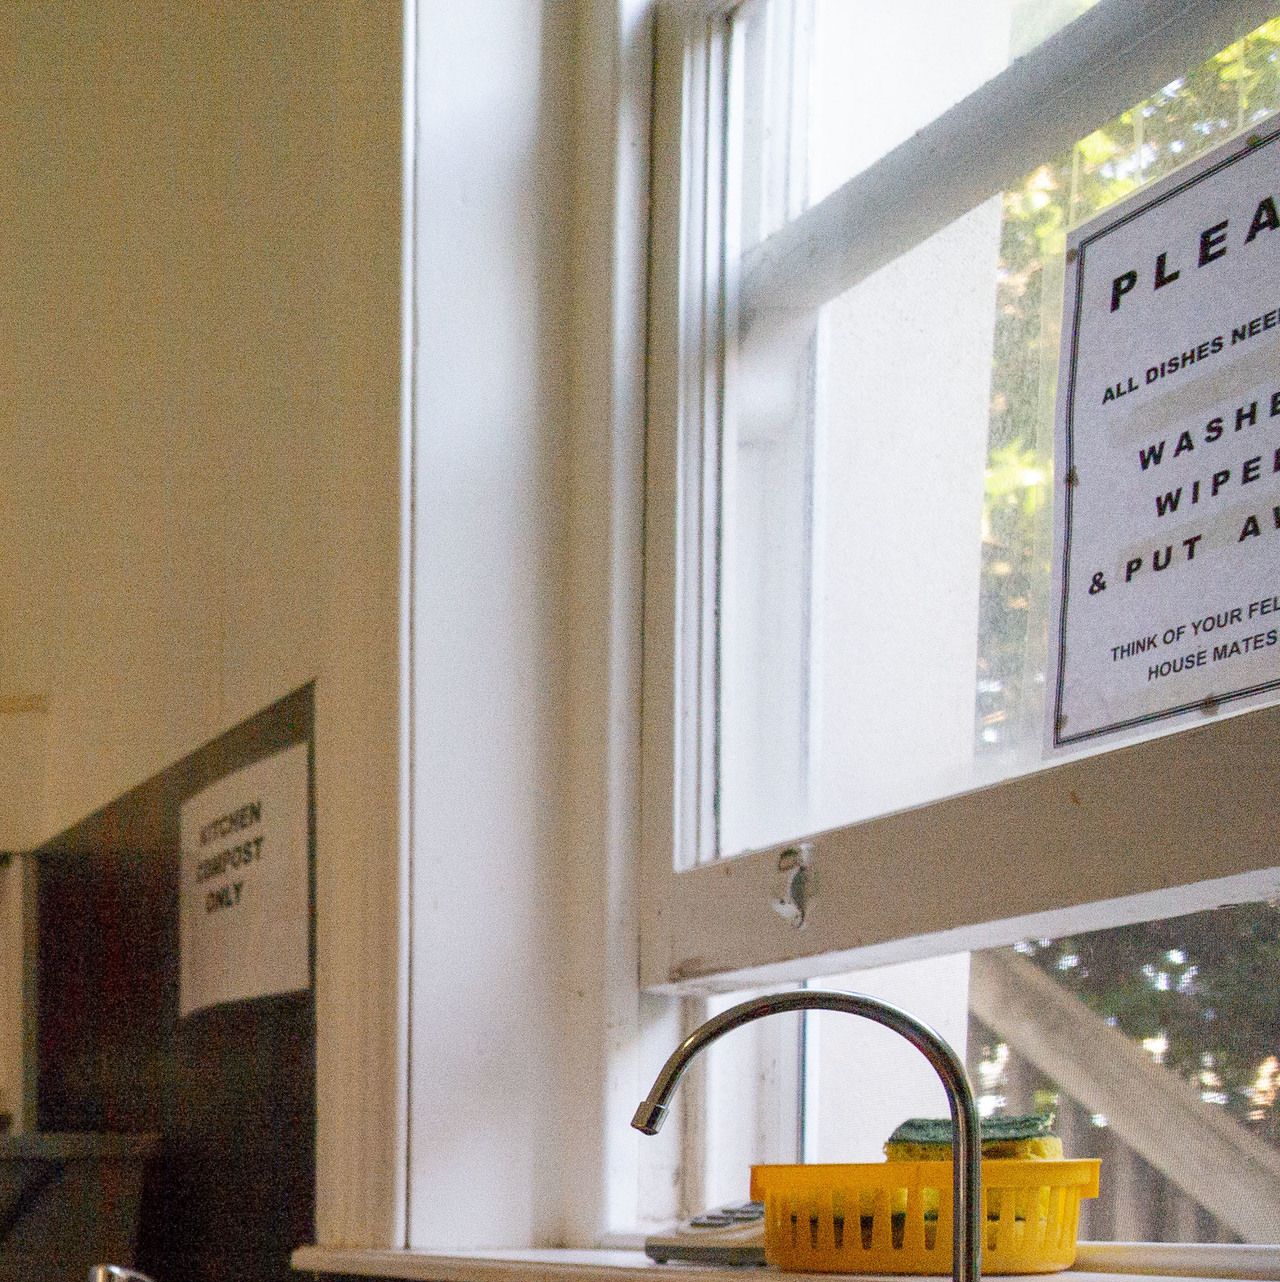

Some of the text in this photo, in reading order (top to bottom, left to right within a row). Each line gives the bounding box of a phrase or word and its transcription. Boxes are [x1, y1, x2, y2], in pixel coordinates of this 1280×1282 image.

[1109, 195, 1280, 314] PLEA
[1101, 307, 1280, 405] ALL DISHES NEE
[1087, 571, 1108, 596] &
[1124, 533, 1202, 583] PUT
[1110, 633, 1158, 663] THINK
[1162, 625, 1187, 646] OF
[1191, 607, 1243, 637] YOUR
[1147, 629, 1278, 682] HOUSE MATES
[199, 800, 262, 847] KITCHEN
[204, 881, 244, 915] ONLY
